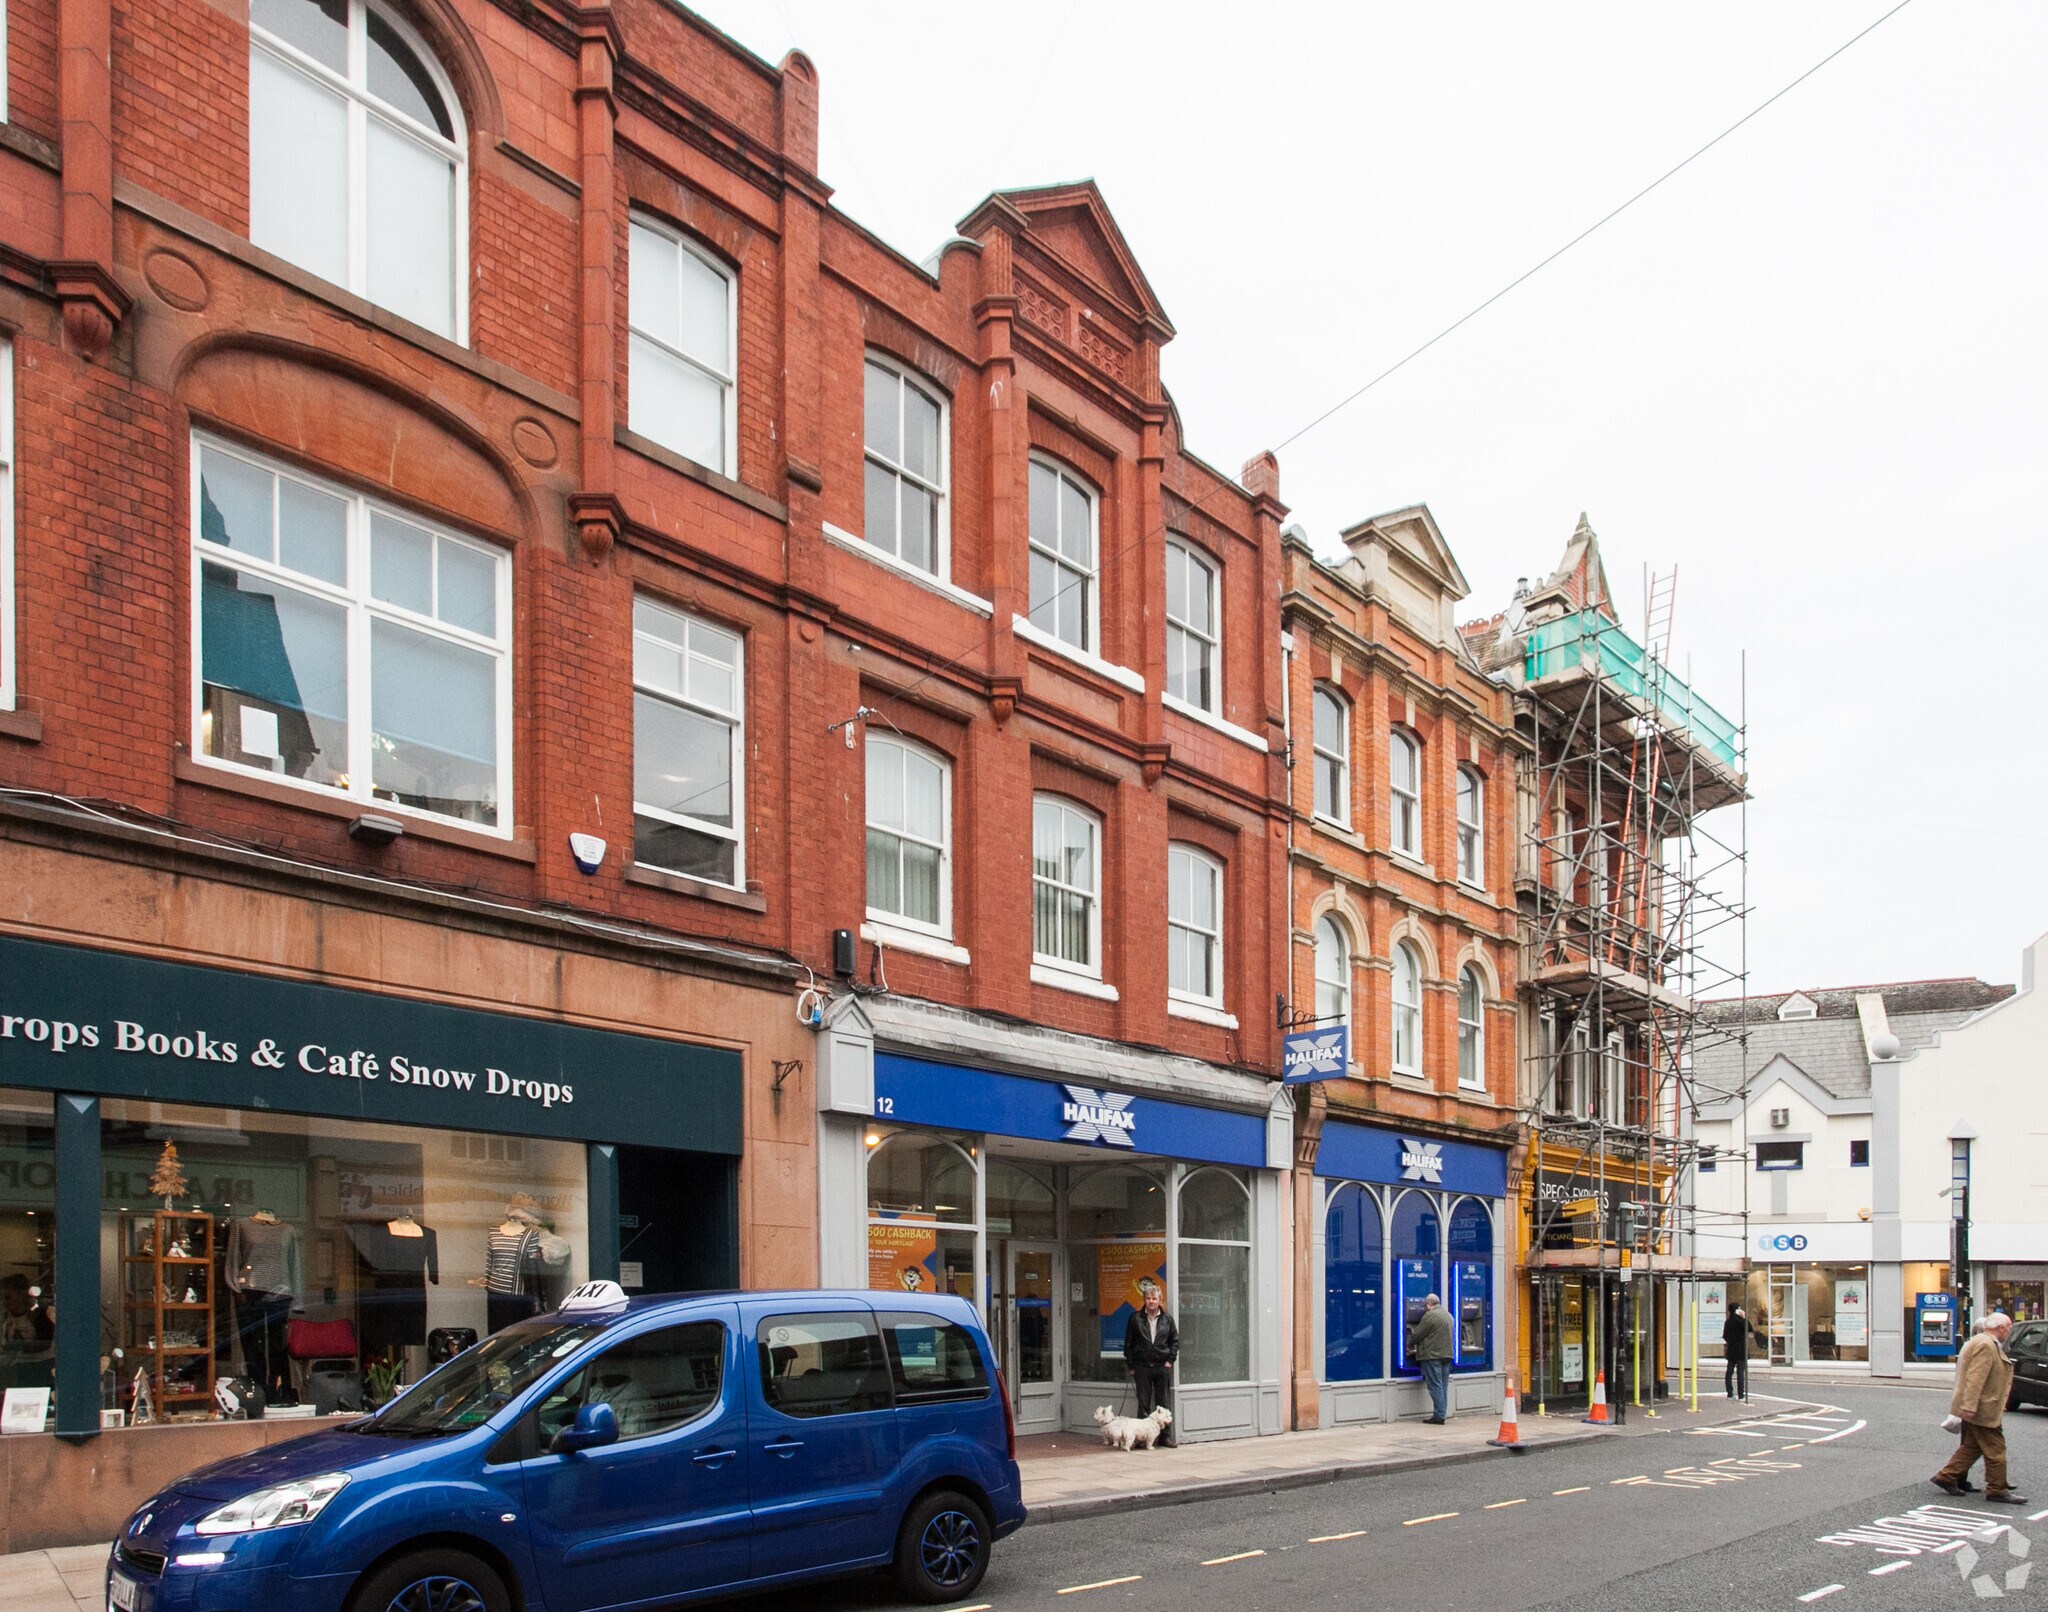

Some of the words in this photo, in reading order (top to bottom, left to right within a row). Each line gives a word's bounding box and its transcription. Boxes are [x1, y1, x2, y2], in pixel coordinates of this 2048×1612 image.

[114, 1020, 238, 1063] Books
[251, 1038, 286, 1069] &
[298, 1044, 380, 1080] Café
[390, 1055, 477, 1091] Snow
[485, 1068, 573, 1108] Drops
[1285, 1045, 1344, 1066] HALIFAX
[877, 1096, 894, 1114] 12
[1063, 1102, 1136, 1130] HALIFAX
[1401, 1152, 1443, 1171] HALIFAX
[887, 1228, 932, 1239] CASHBACK
[1762, 1236, 1805, 1249] TSB
[1123, 1243, 1164, 1254] CASHBACK
[1628, 1459, 1802, 1489] TAXIS
